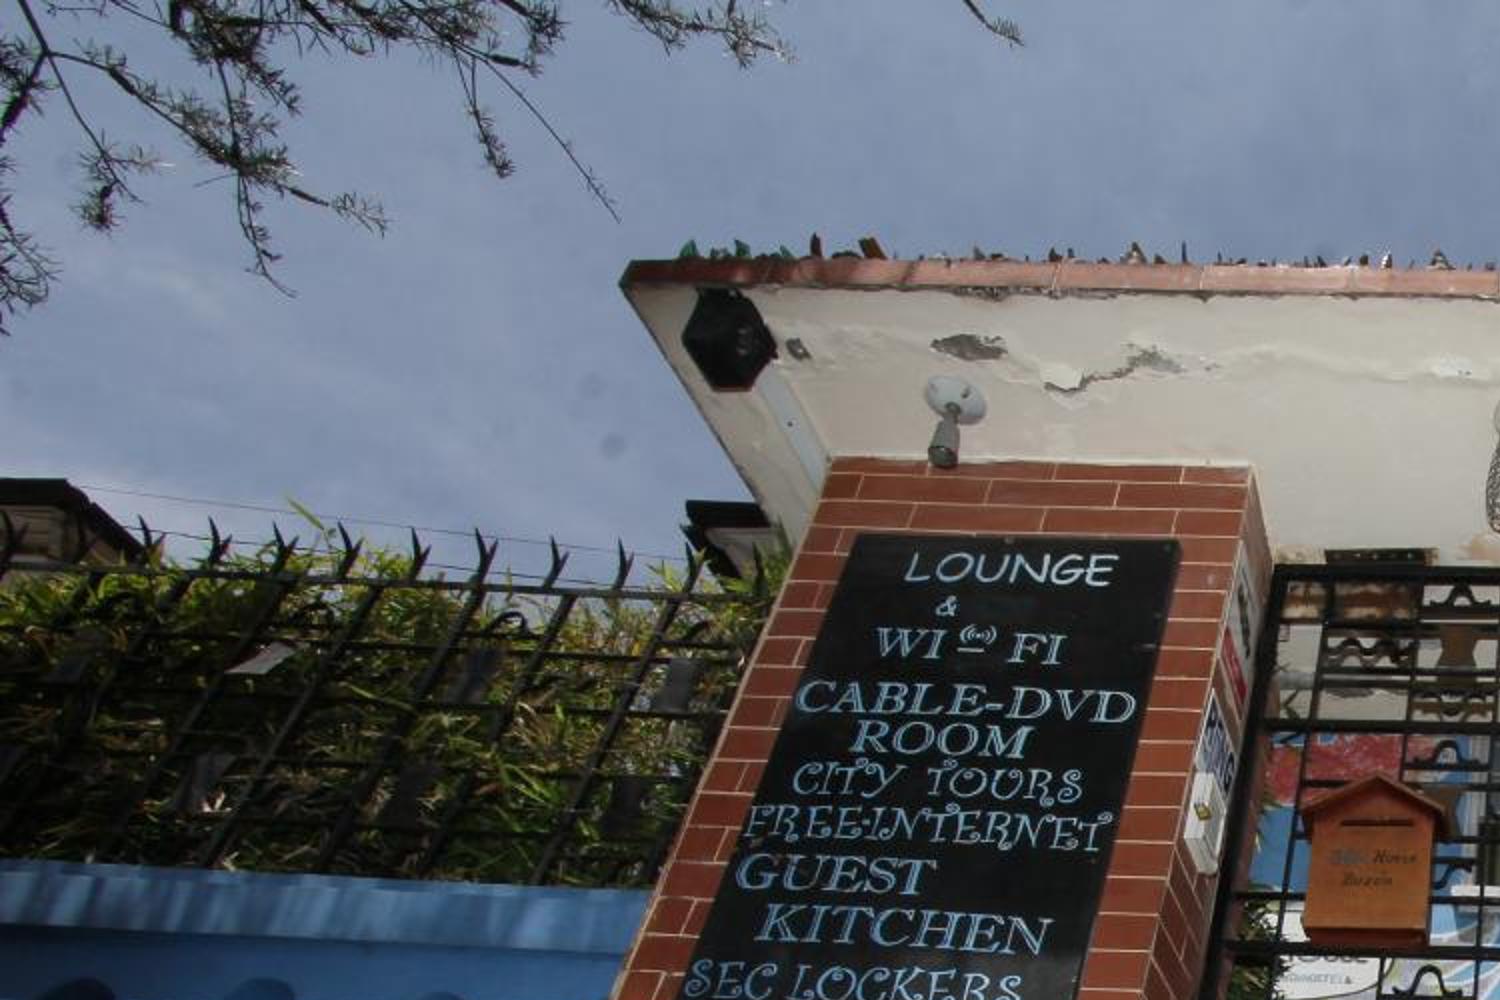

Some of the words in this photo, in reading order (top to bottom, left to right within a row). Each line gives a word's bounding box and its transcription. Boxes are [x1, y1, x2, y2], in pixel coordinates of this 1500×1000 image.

[905, 552, 1119, 587] LOUNGE
[934, 595, 959, 617] &
[796, 681, 1137, 725] CABLE-DVD
[848, 720, 1037, 760] ROOM
[792, 758, 906, 798] CITY
[927, 759, 1084, 808] TOURS
[735, 852, 938, 896] GUEST
[753, 902, 1056, 957] KITCHEN
[684, 958, 777, 1000] SEC
